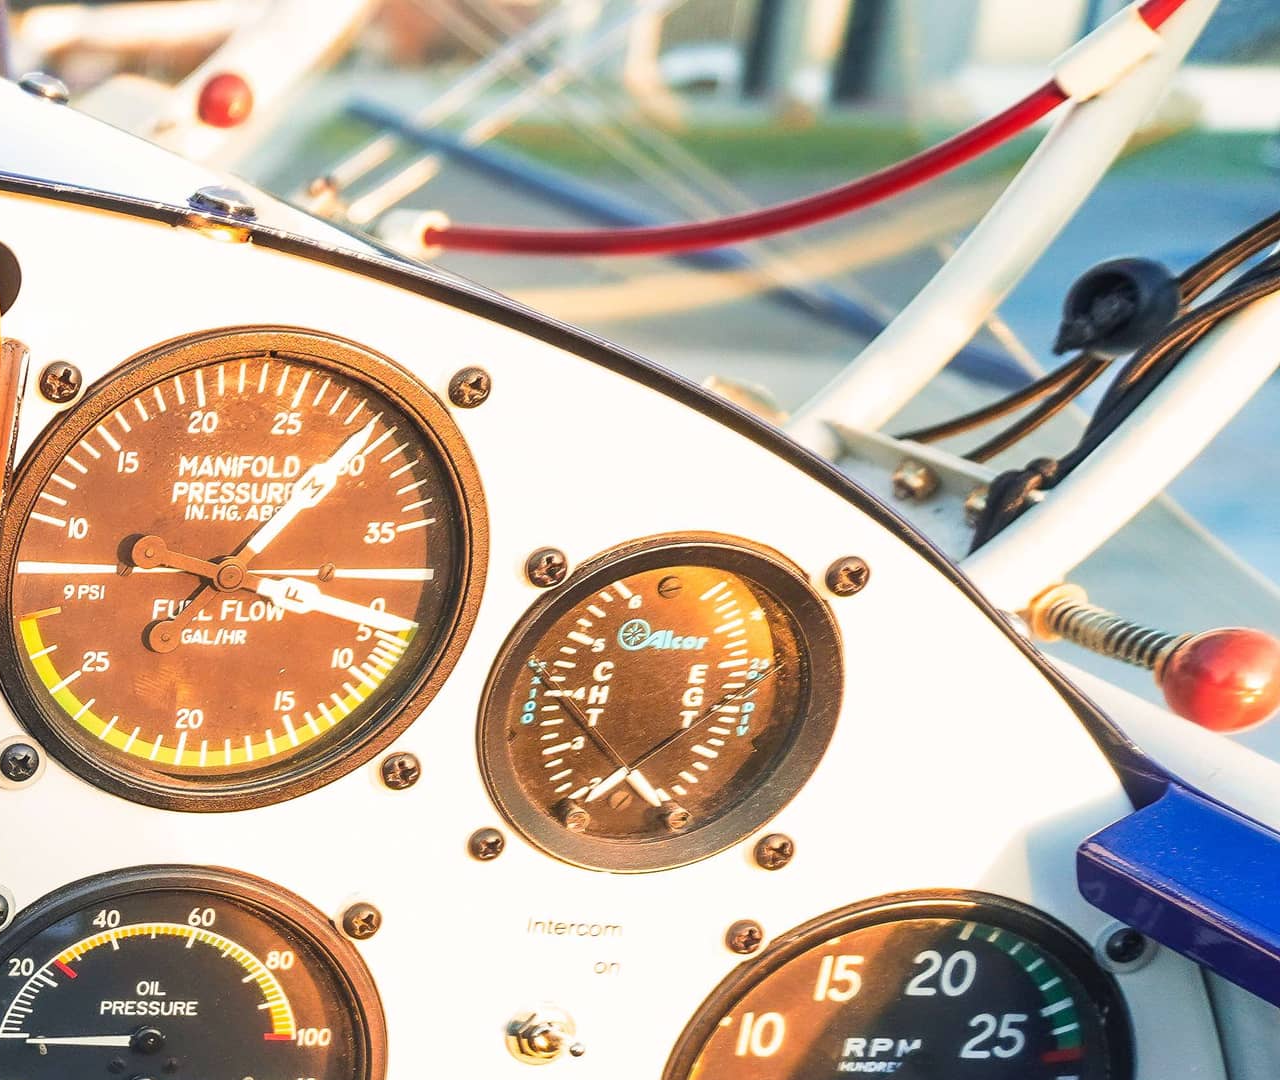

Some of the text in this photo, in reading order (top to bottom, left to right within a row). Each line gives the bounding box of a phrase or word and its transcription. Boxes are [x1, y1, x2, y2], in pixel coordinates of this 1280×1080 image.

[187, 411, 218, 434] 20
[271, 412, 302, 435] 25
[117, 451, 139, 474] 15
[178, 456, 301, 478] MANIFOLD
[67, 517, 88, 540] 10
[364, 522, 396, 544] 35
[63, 585, 105, 600] 9 PSI
[221, 600, 285, 621] FLOW
[181, 629, 247, 645] GAL/HR
[646, 629, 709, 650] Alcor
[81, 651, 110, 672] 25
[331, 647, 353, 669] 10
[273, 691, 296, 711] 15
[175, 709, 204, 730] 20
[93, 910, 121, 928] 40
[188, 909, 215, 926] 60
[527, 917, 624, 937] Intercom
[8, 958, 34, 977] 20
[266, 951, 293, 969] 80
[593, 961, 621, 975] on
[813, 954, 865, 1002] 15
[905, 950, 978, 997] 20
[136, 981, 166, 996] OIL
[100, 1001, 198, 1016] PRESSURE
[297, 1028, 331, 1047] 100
[735, 1011, 785, 1057] 10
[960, 1013, 1029, 1059] 25
